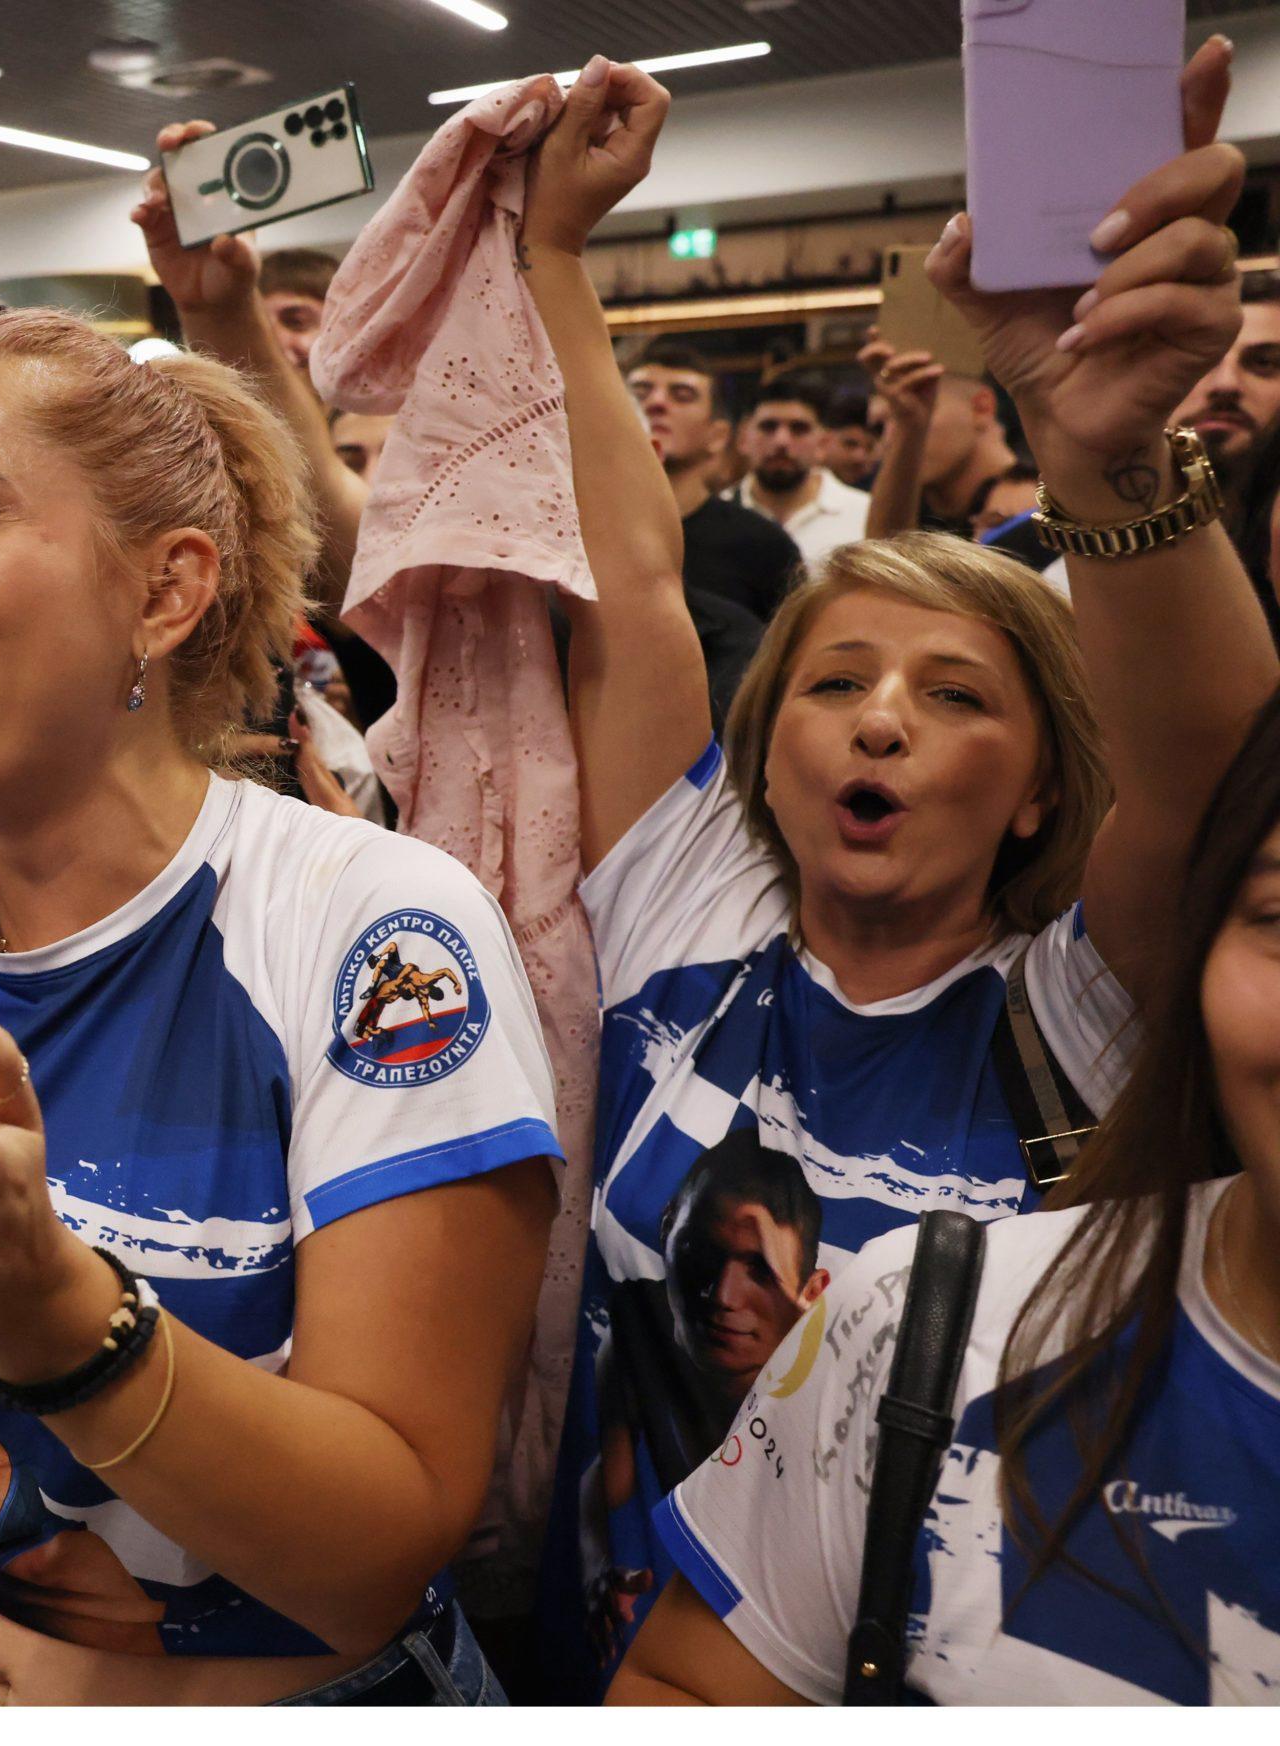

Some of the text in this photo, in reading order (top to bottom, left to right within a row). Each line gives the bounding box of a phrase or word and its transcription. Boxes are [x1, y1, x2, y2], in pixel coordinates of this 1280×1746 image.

[338, 916, 480, 1017] ΛΗΤΙΚΟ ΚΕΝΤΡΟ ΠΑΛΗΣ
[352, 1021, 482, 1083] ΤΡΑΠΕΖΟΥΝΤΑ
[749, 1416, 785, 1480] 024
